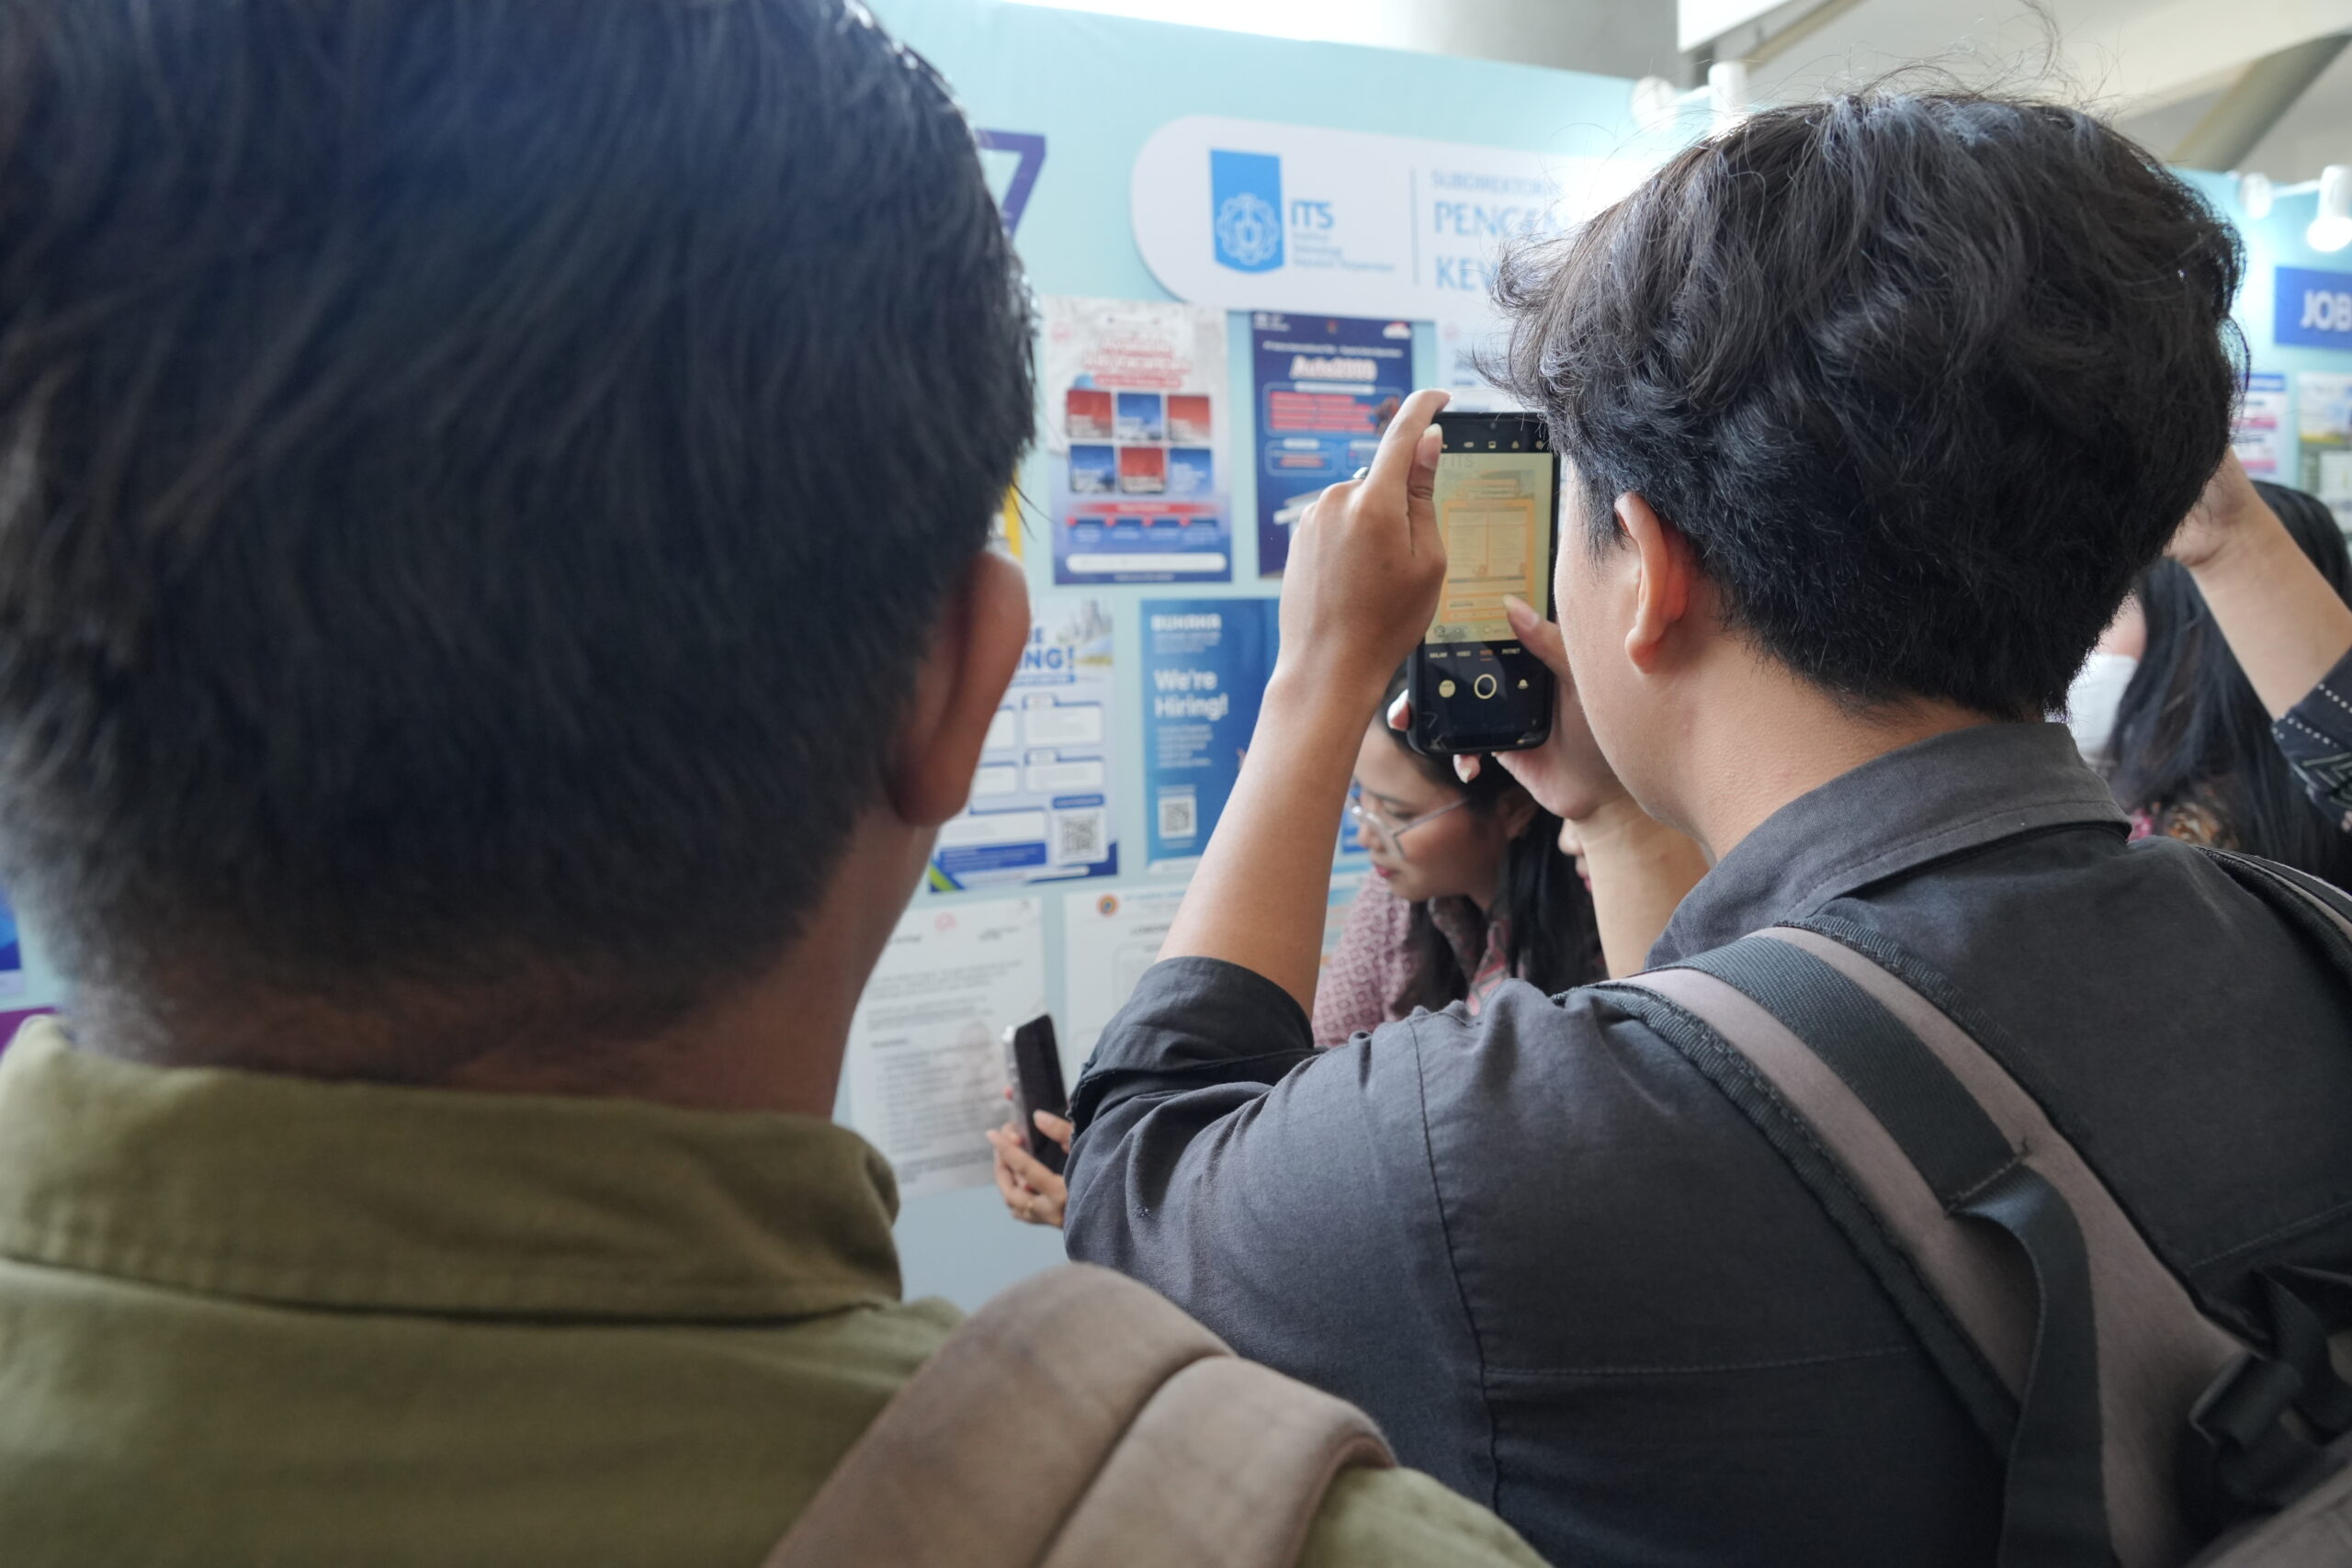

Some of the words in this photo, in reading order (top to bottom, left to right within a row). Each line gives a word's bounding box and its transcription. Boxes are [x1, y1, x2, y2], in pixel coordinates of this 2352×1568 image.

[1291, 198, 1335, 230] ITS
[2301, 290, 2352, 332] JOB
[1153, 669, 1218, 691] We're
[1154, 693, 1229, 721] Hiring!
